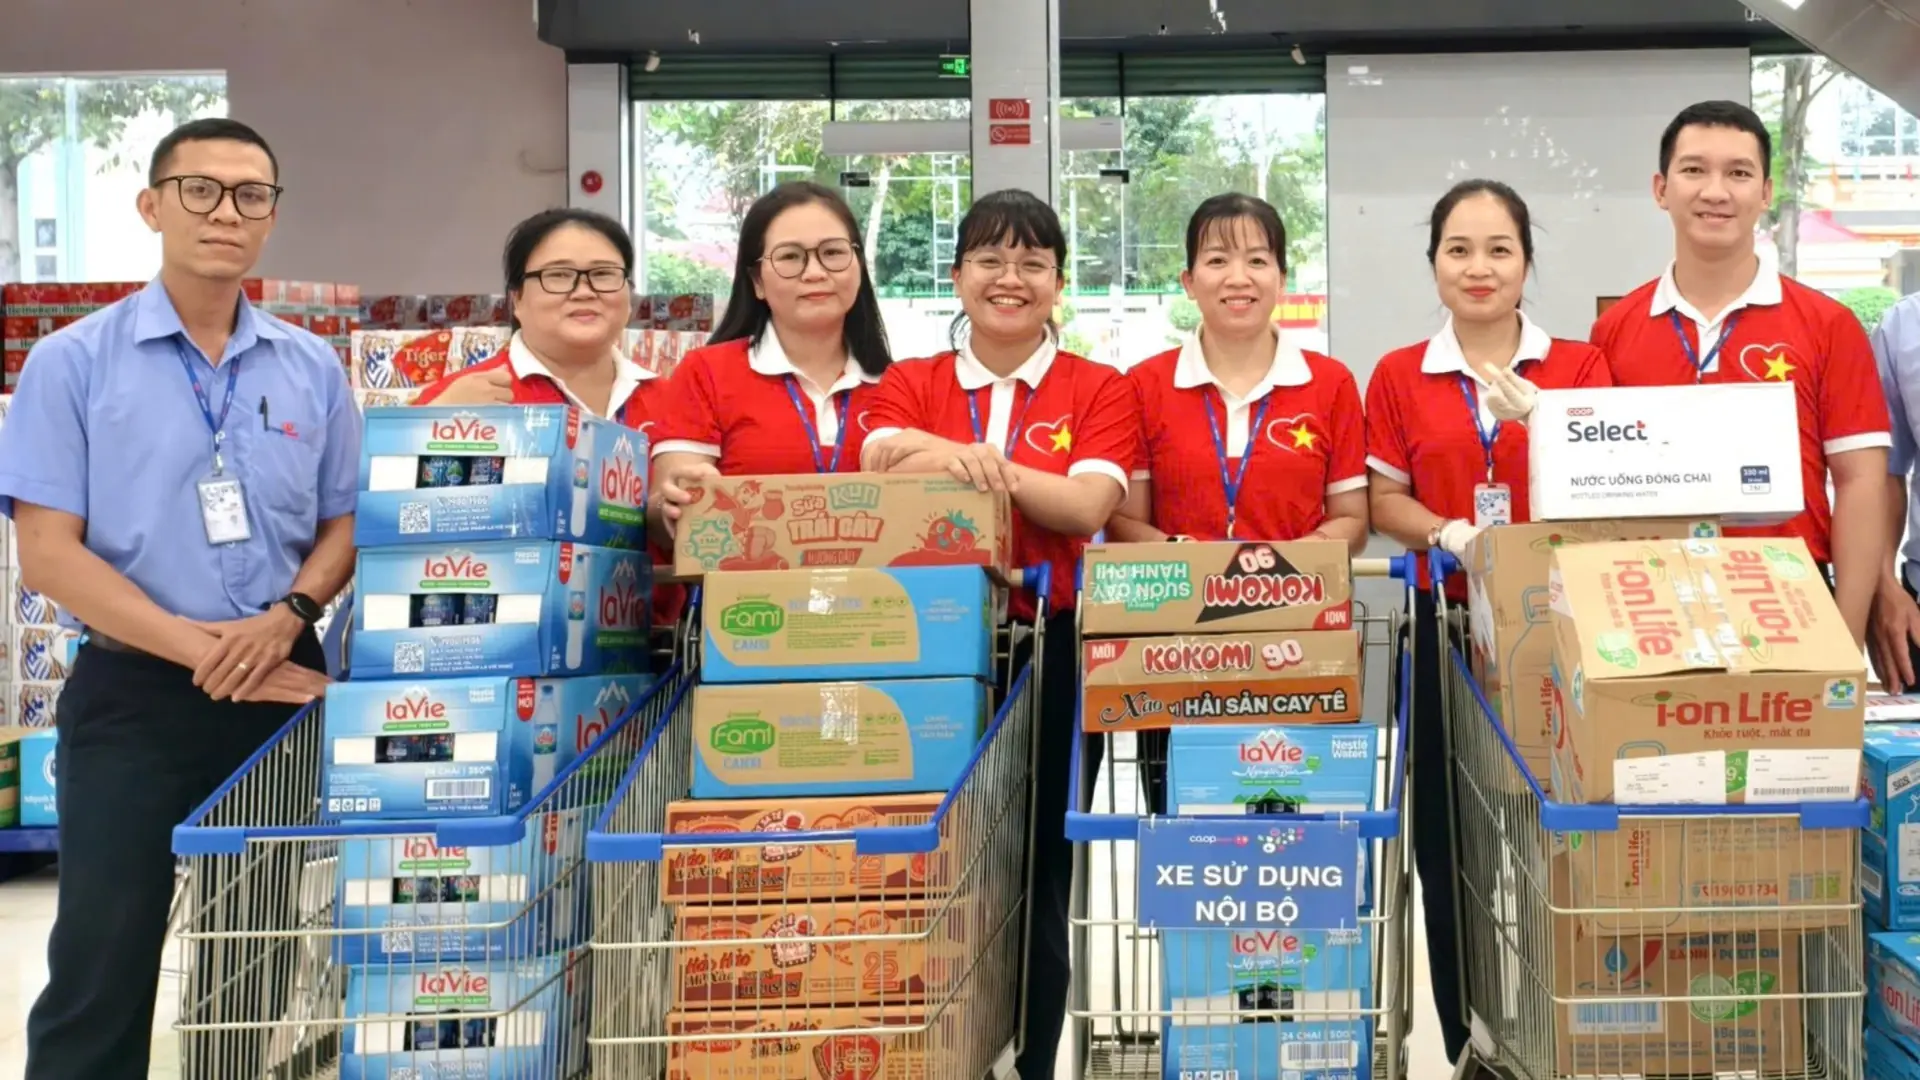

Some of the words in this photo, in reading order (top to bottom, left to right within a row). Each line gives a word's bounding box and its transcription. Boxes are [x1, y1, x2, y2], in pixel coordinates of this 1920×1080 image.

[405, 347, 447, 369] Tiger
[432, 418, 496, 440] laVie
[1567, 420, 1648, 443] Select
[601, 456, 644, 506] laVie
[1571, 475, 1606, 486] NƯỚC
[1608, 471, 1643, 485] UỐNG
[1645, 472, 1681, 484] ĐÓNG
[1683, 472, 1712, 483] CHAI
[424, 555, 488, 578] laVie
[1239, 547, 1276, 573] 90
[1721, 550, 1775, 594] Life
[1205, 573, 1324, 606] KOKOMI
[1629, 609, 1682, 656] Life
[1092, 643, 1116, 659] MỚI
[1143, 643, 1253, 674] KOKOMI
[1262, 639, 1303, 671] 90
[386, 696, 445, 720] laVie
[1185, 690, 1221, 717] HẢI
[1225, 689, 1267, 715] SẢN
[1271, 694, 1313, 714] CAY
[1318, 688, 1348, 713] TÊ
[1739, 691, 1813, 724] Life
[1796, 726, 1811, 737] da
[1240, 740, 1303, 762] laVie
[1892, 775, 1911, 791] SGS
[1156, 866, 1193, 886] XE
[1203, 861, 1249, 887] SỬ
[1259, 866, 1342, 891] DỤNG
[1196, 895, 1246, 927] NỘI
[1256, 896, 1298, 927] BỘ
[863, 951, 899, 981] 25
[420, 970, 487, 993] laVie
